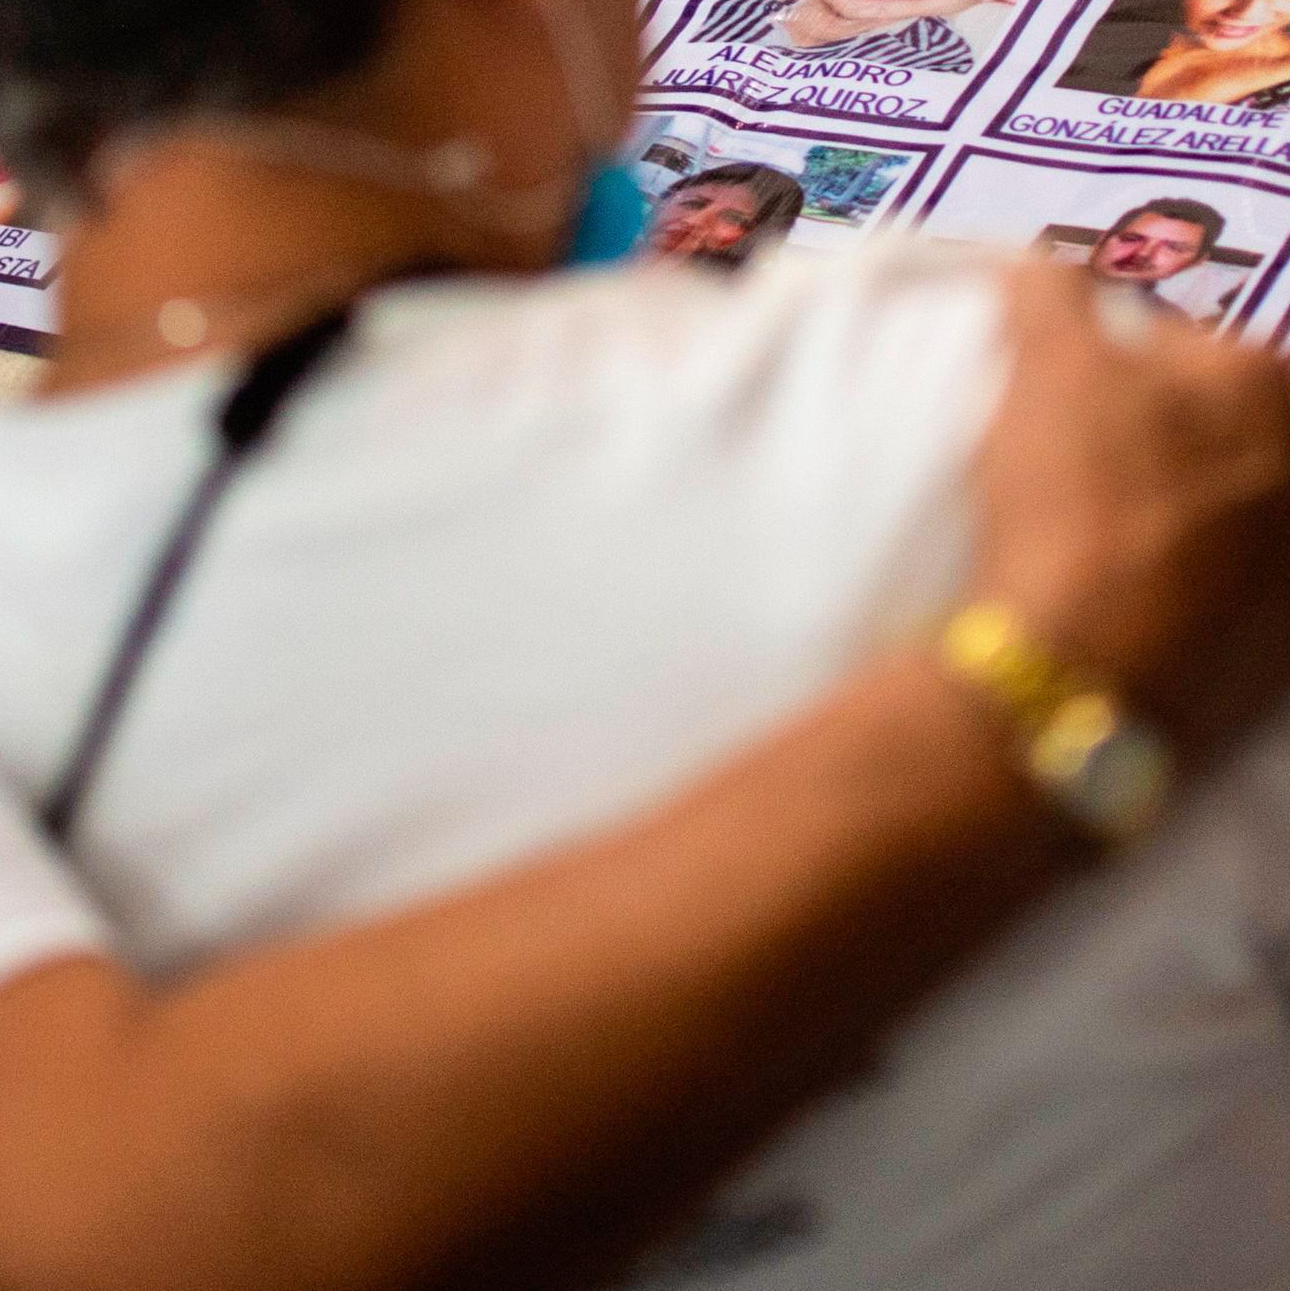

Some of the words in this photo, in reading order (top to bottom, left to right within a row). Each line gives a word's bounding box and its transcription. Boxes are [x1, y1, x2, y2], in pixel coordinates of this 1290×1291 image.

[707, 44, 913, 87] ALEJANDRO
[653, 63, 790, 105] JUÁREZ
[789, 83, 928, 122] QUIROZ.
[1008, 114, 1173, 147] GONZÁLEZ
[1097, 96, 1287, 130] GUADALUPE
